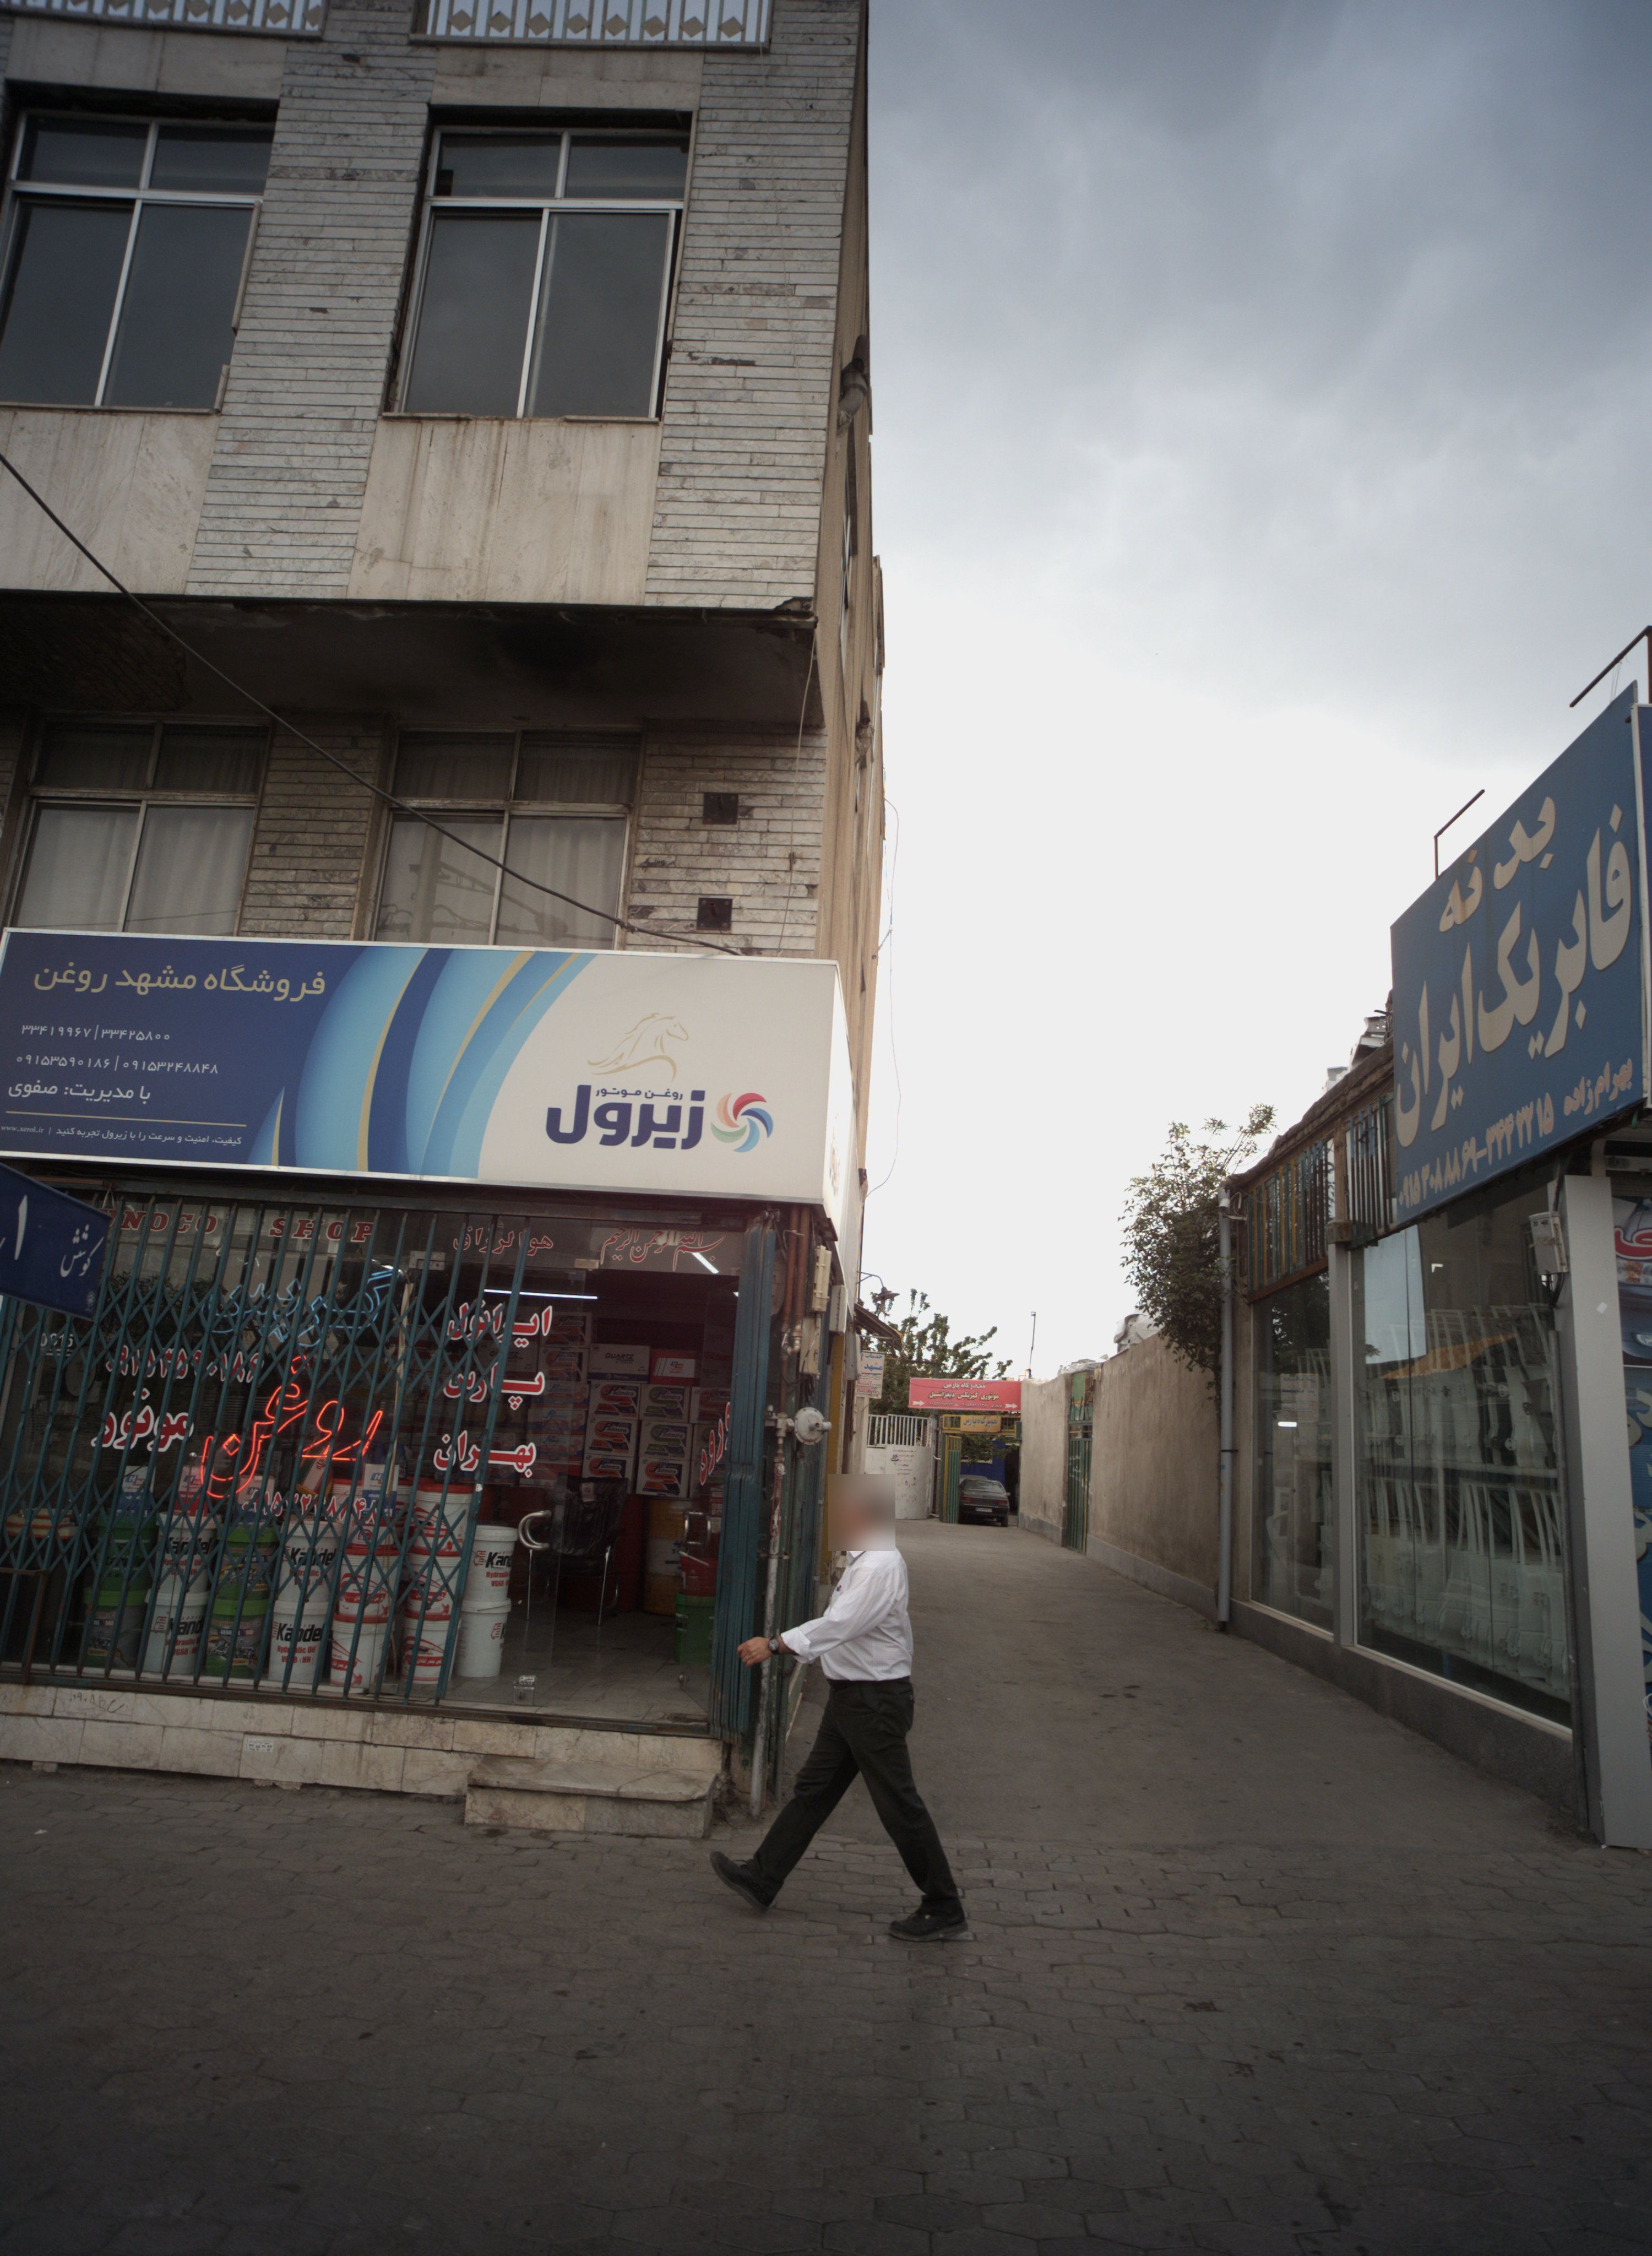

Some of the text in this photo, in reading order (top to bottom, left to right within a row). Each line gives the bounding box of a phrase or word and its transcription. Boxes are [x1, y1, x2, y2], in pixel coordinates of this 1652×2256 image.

[34, 961, 326, 1002] فروشگاه مشهد روغن
[1396, 804, 1632, 1148] فابریک ایران
[21, 1024, 170, 1041] ۳۳۴۱۹۹۶۷ ۳۳۴۲۵۸۰۰
[17, 1055, 218, 1074] ۰۹۱۵۳۵۹۰۱۸۶ ۰۹۱۵۳۲۴۸۸۴۸
[8, 1080, 57, 1098] صفوی
[140, 1086, 151, 1104] با
[595, 1087, 683, 1100] روغن موتور
[545, 1084, 705, 1150] زیرول
[56, 1126, 74, 1136] کنید
[77, 1129, 100, 1138] تجربه
[101, 1128, 127, 1141] زیرول
[129, 1131, 136, 1142] با
[138, 1132, 146, 1142] را
[148, 1133, 175, 1143] سرعت
[184, 1135, 210, 1145] امنیت
[269, 1217, 375, 1243] SHOP
[60, 1223, 105, 1278] کوشش
[600, 1226, 727, 1272] بسم الله الرحمن الرحیم
[443, 1362, 545, 1411] پارس
[90, 1387, 194, 1452] موتور
[433, 1429, 536, 1478] بهران
[290, 1548, 337, 1566] Kadel
[277, 1645, 307, 1653] Hydrulic
